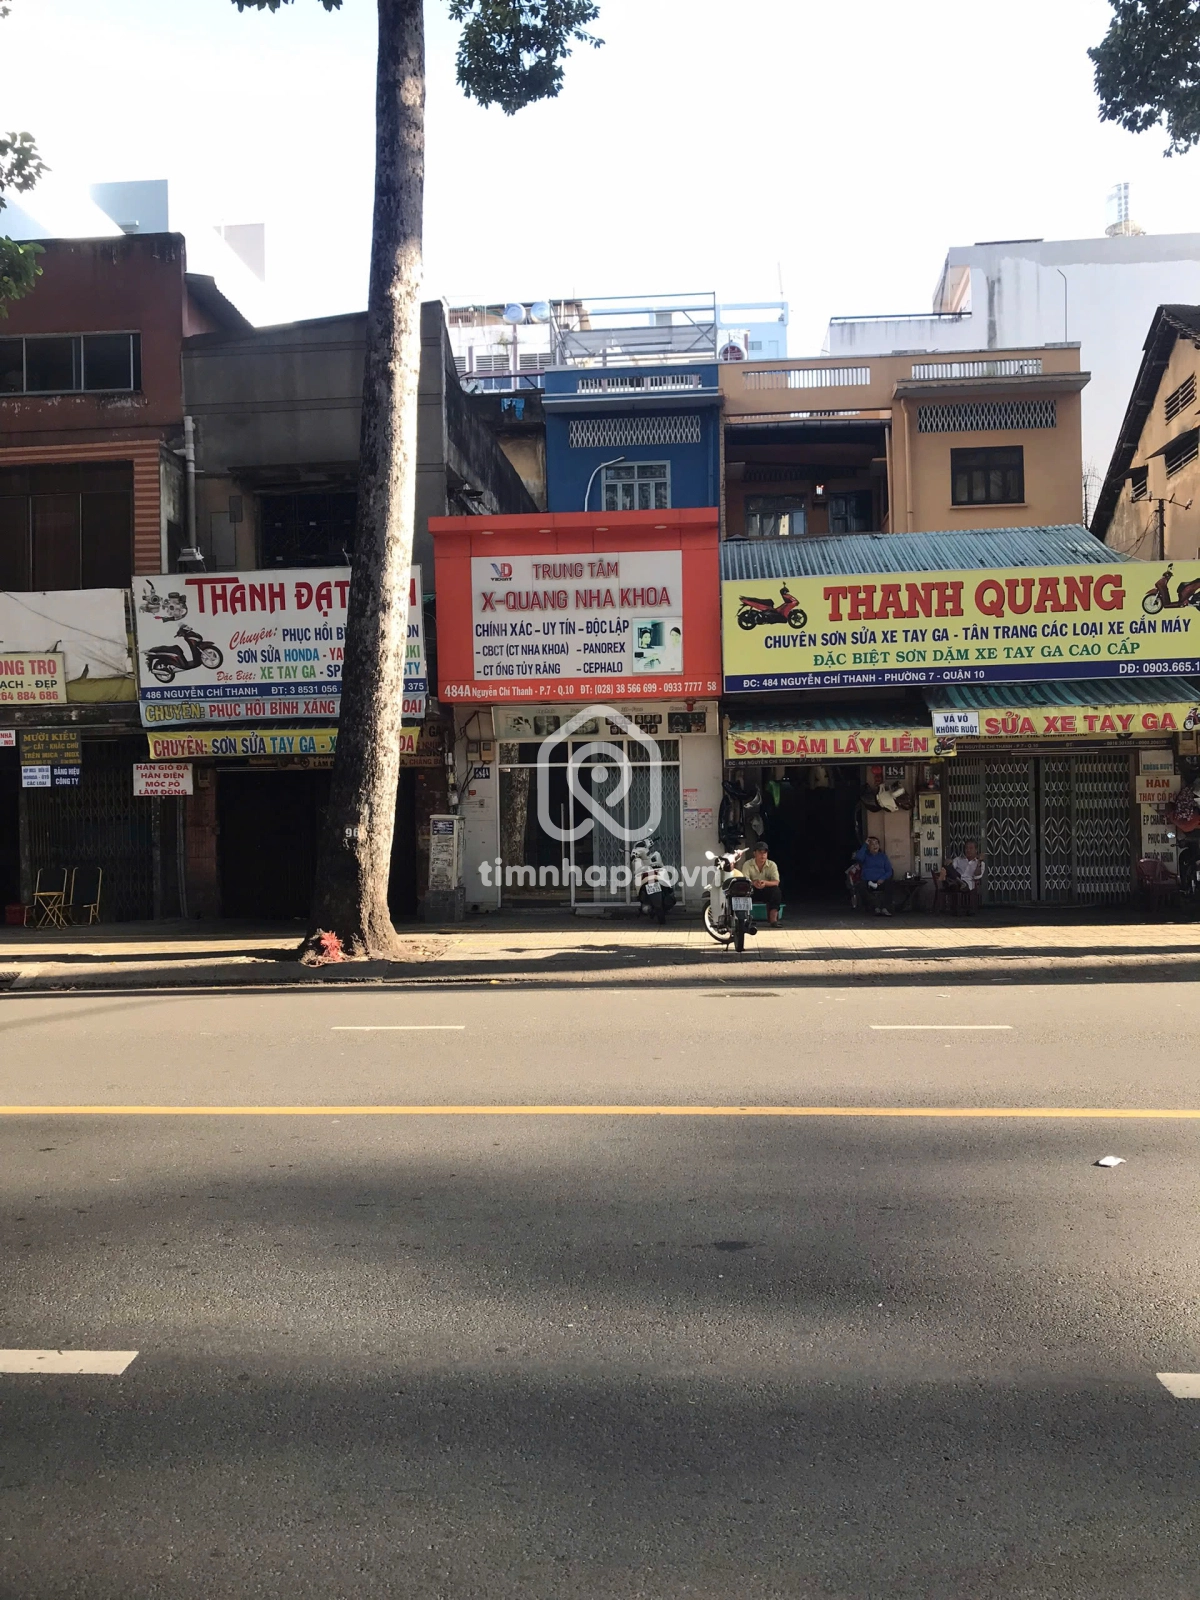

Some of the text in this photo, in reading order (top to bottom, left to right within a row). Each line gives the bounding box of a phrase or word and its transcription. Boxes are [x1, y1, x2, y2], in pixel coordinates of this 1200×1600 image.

[532, 558, 619, 580] TRUNG TÂM
[185, 577, 350, 617] THANH ĐẠT
[481, 586, 672, 613] X-QUANG NHA KHOA
[823, 574, 1126, 622] THANH QUANG
[229, 622, 333, 650] Chuyên: PHỤC HỒI
[475, 616, 630, 638] CHÍNH XÁC UY TÍN ĐỘC LẬP
[764, 614, 1191, 649] CHUYÊN SƠN SỬA XE TAY GA TÂN TRANG CÁC LOẠI XE GẮN MÁY
[237, 644, 320, 664] SƠN SỬA HONDA
[482, 642, 570, 658] CBCT (CT NHA KHOA)
[583, 642, 626, 654] PANOREX
[813, 637, 1140, 668] ĐẶC BIỆT SƠN DẶM XE TAY GA CAO CẤP
[28, 659, 57, 678] TRỌ
[216, 664, 316, 683] Đặc Biệt: XE TAY GA
[483, 660, 561, 676] CT ỐNG TỦY RĂNG
[583, 662, 623, 674] CEPHALO
[1119, 661, 1200, 674] DĐ: 0903.665.1
[35, 680, 58, 690] ĐẸP
[408, 682, 424, 691] 375
[743, 670, 985, 688] ĐC: 484 NGUYỄN CHÍ THANH PHƯỜNG 7 QUẬN 10
[17, 691, 59, 700] 884 686
[164, 686, 204, 698] NGUYỄN
[206, 686, 223, 697] CHÍ
[225, 687, 258, 696] THANH
[271, 686, 287, 695] ĐT:
[298, 685, 318, 693] 8531
[322, 685, 338, 693] 056
[444, 682, 717, 698] 484A Nguyễn Chí Thanh P.7 Q.10 ĐT: (028) 38 566 699 0933 7777 58
[146, 698, 336, 722] CHUYÊN: PHỤC BÌNH XĂNG
[936, 724, 978, 735] KHÔNG RUỘT
[985, 711, 1178, 734] SỬA XE TAY GA
[153, 731, 316, 758] CHUYÊN: SƠN SỬA TAY GA
[734, 731, 928, 758] SƠN DẶM LẤY LIỀN
[141, 771, 161, 779] HÀN
[886, 767, 904, 775] 484
